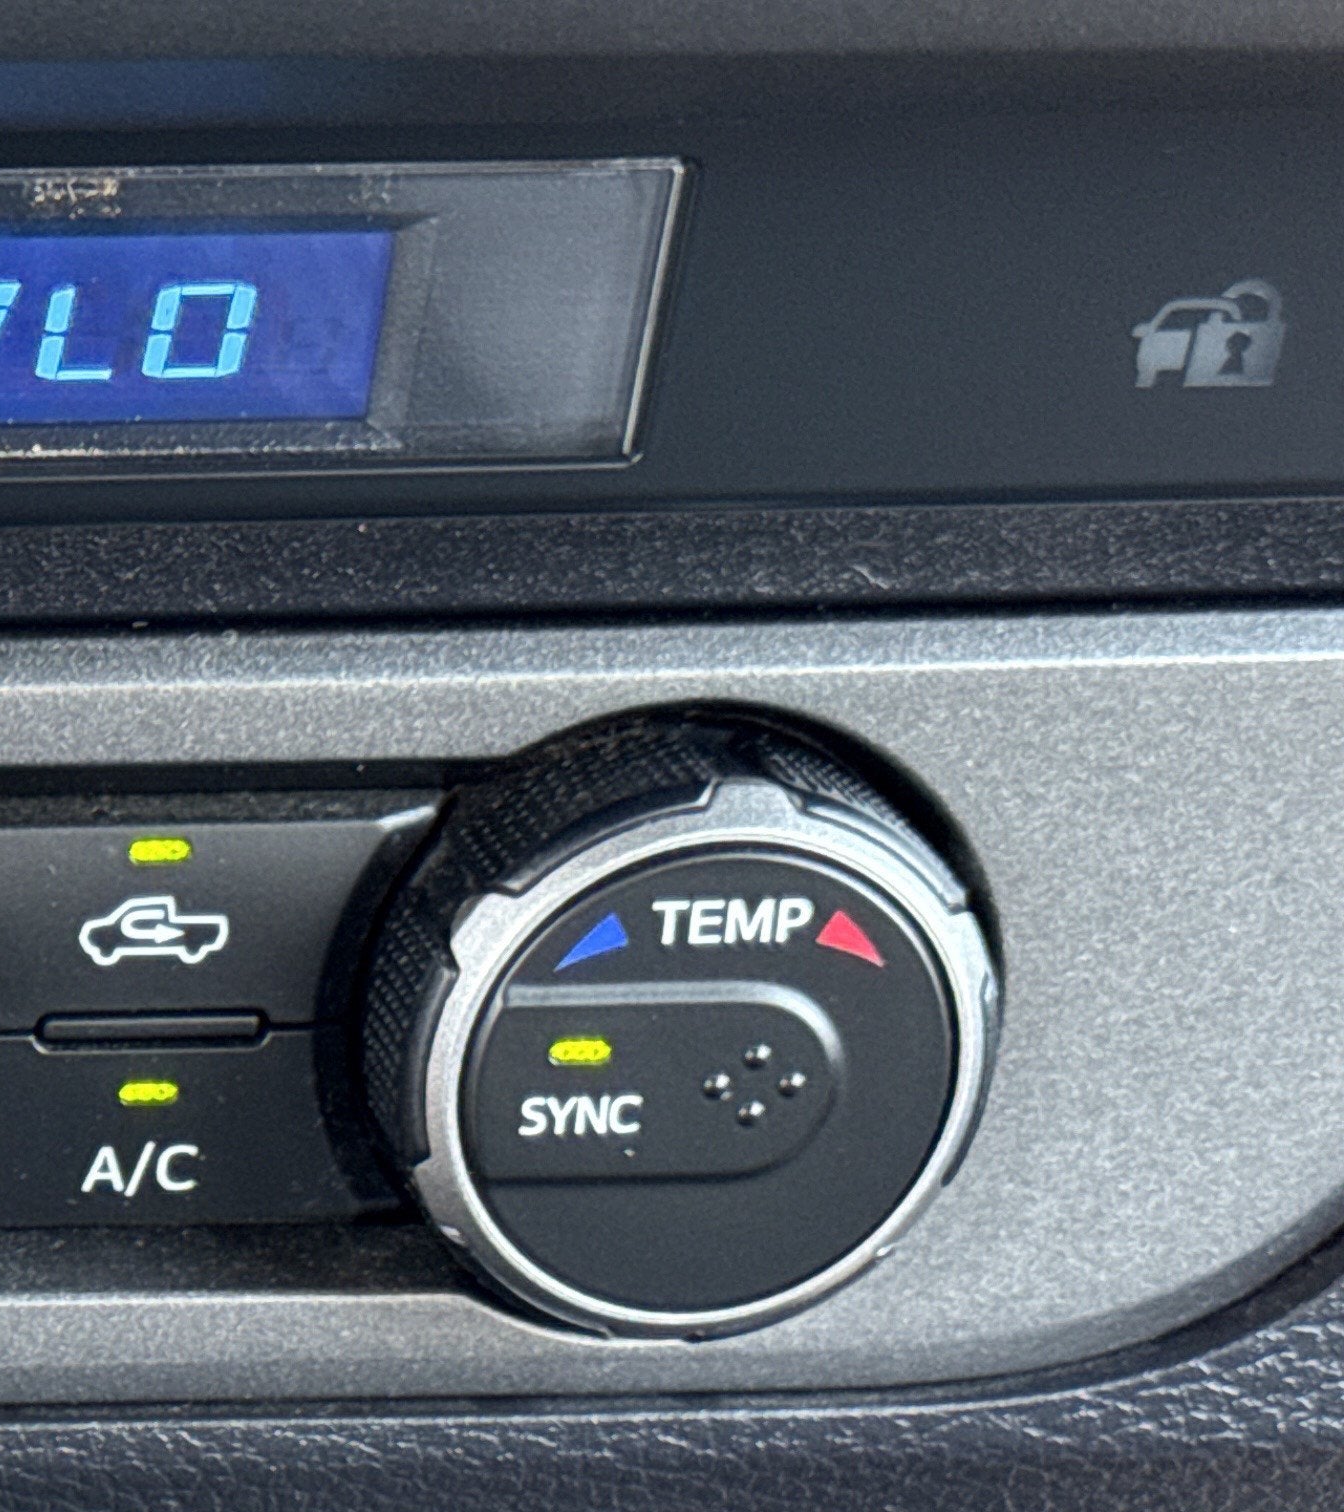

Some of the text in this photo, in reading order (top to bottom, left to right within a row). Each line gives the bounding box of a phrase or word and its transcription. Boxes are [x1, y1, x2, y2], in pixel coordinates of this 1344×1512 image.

[651, 897, 814, 946] TEMP
[518, 1094, 643, 1137] SYNC
[81, 1141, 199, 1197] A/C
